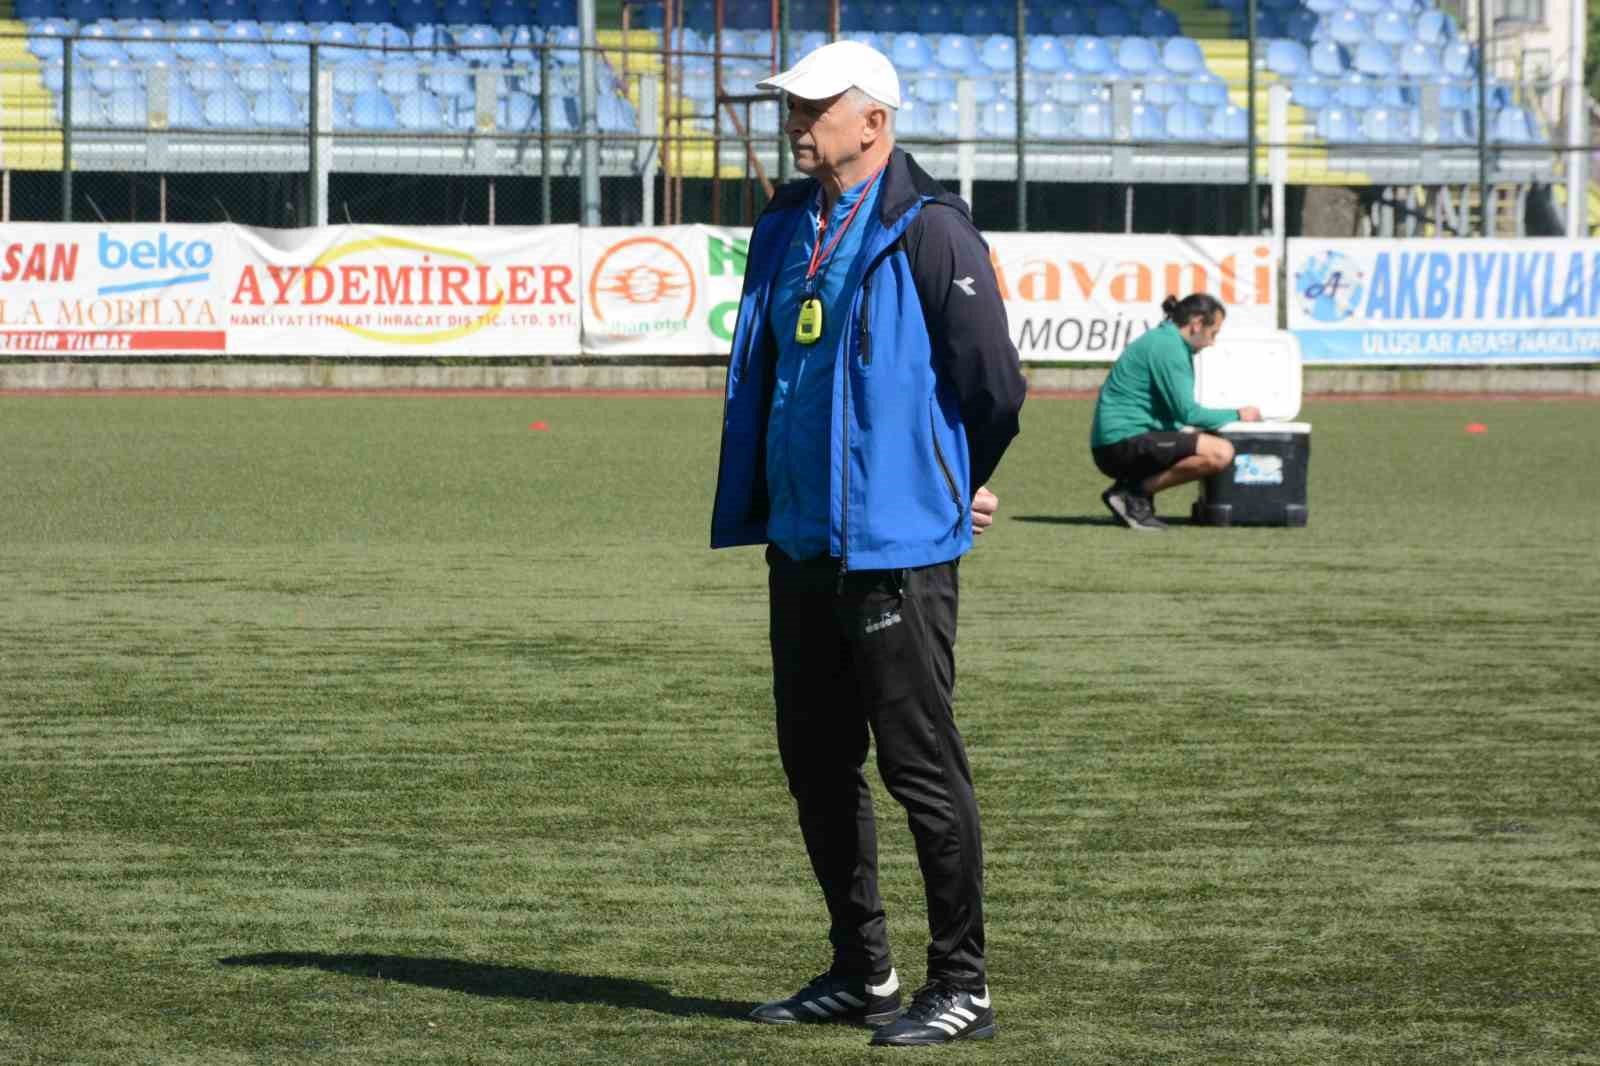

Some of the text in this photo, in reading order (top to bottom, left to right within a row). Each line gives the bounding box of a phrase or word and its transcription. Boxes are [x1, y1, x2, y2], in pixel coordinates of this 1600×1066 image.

[1, 243, 78, 282] SAN
[97, 231, 213, 269] beko
[231, 255, 575, 305] AYDEMİRLER
[56, 296, 216, 326] MOBİLYA
[230, 313, 303, 327] NAKLİYAT
[308, 313, 371, 326] İTHALAT
[378, 313, 441, 327] İHRACAT
[1018, 312, 1152, 351] MOBİL
